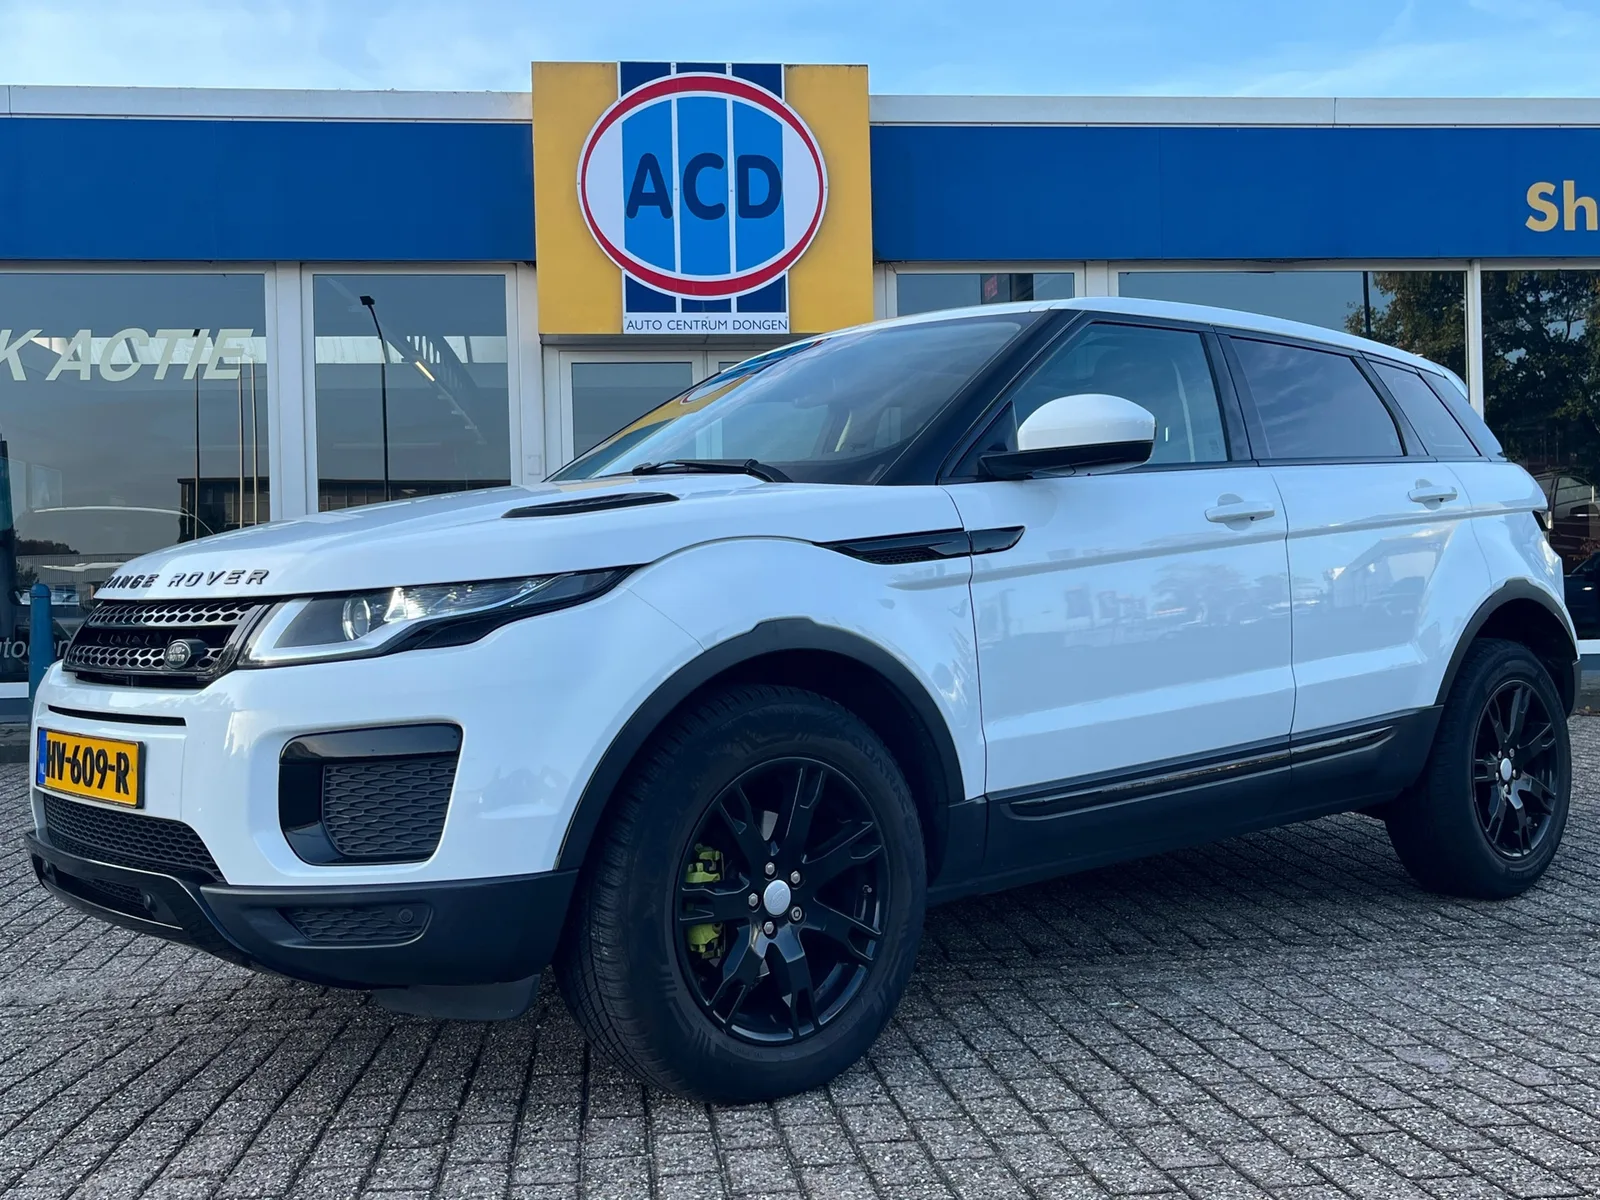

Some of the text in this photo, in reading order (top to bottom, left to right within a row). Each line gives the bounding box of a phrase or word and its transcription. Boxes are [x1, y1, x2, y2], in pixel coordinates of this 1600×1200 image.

[626, 152, 782, 220] ACD
[1525, 180, 1598, 232] Sh
[626, 319, 788, 331] AUTO CENTRUM DONGEN
[0, 327, 254, 382] K ACTIE
[167, 568, 270, 588] ROVER
[46, 739, 130, 796] HV-609-R
